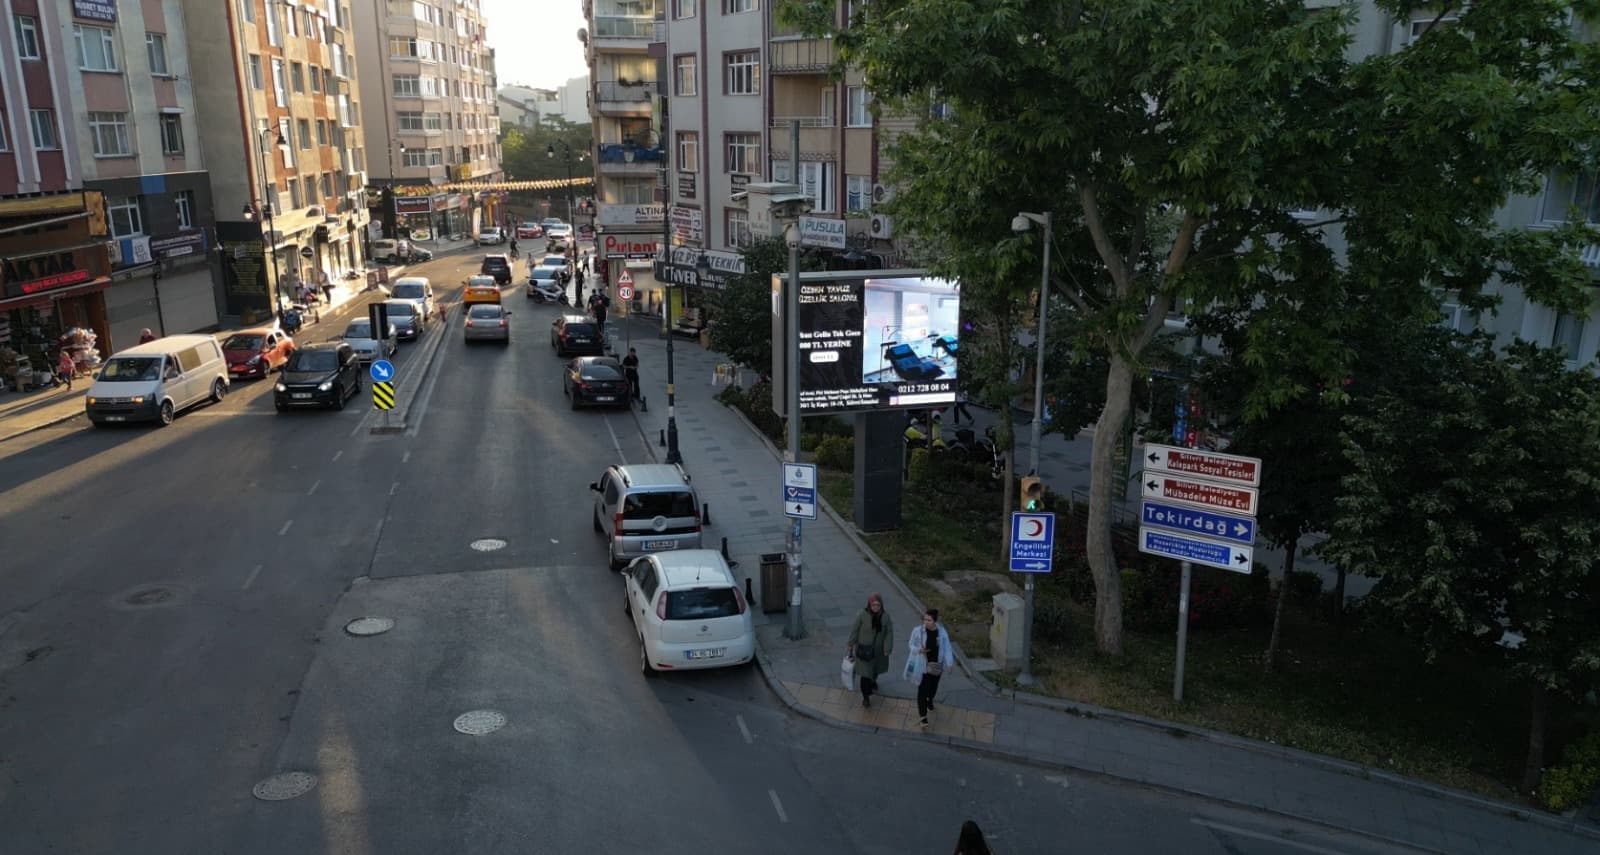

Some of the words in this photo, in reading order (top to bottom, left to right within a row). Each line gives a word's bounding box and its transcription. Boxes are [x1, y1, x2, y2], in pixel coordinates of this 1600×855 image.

[805, 220, 844, 234] PUSULA
[898, 384, 915, 393] 0212
[916, 384, 930, 392] 728
[940, 383, 949, 391] 04
[1167, 460, 1199, 471] Kalepark
[1200, 463, 1222, 476] Sosyal
[1224, 467, 1255, 480] Tesisleri
[1164, 488, 1207, 502] Mübadele
[1209, 496, 1233, 506] Müze
[1235, 500, 1249, 511] Evi
[1146, 507, 1227, 535] Tekirdağ
[1014, 542, 1050, 550] Engelliler
[1016, 550, 1047, 558] Merkezi
